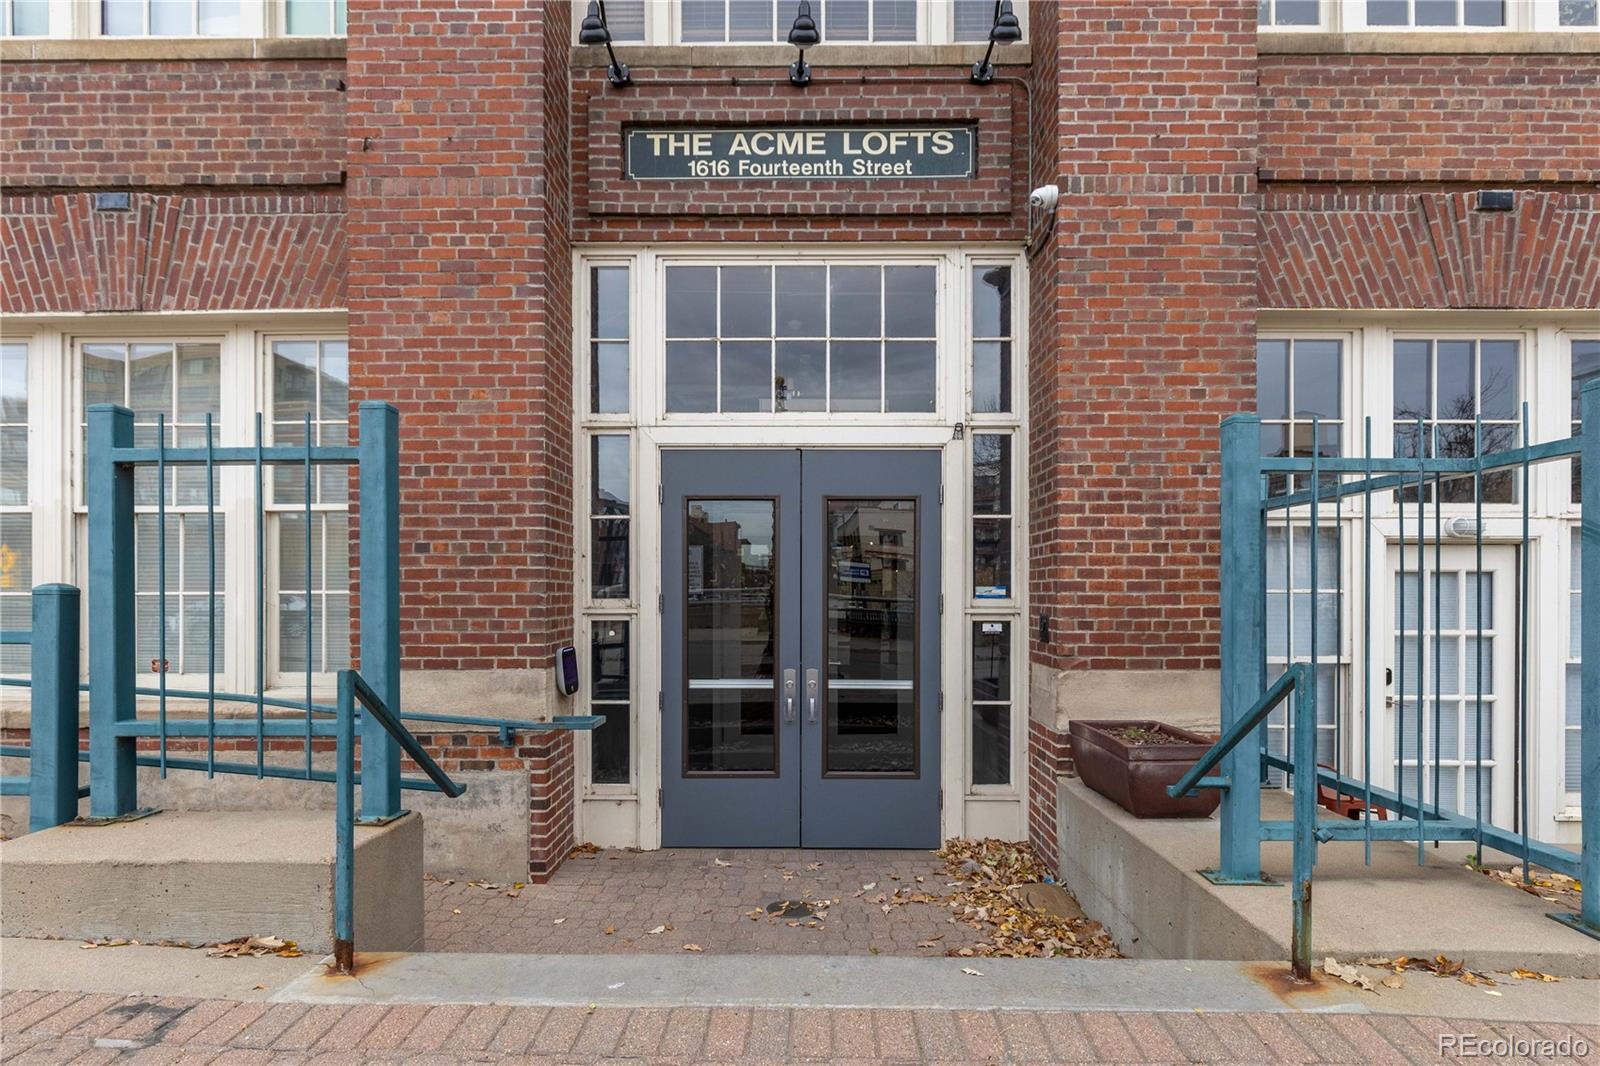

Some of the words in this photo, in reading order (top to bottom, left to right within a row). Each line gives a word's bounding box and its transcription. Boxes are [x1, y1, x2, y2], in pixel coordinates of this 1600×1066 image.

[646, 133, 713, 156] THE
[728, 133, 827, 156] ACME
[842, 131, 955, 155] LOFTS
[687, 160, 730, 176] 1616
[738, 159, 843, 176] Fourteenth
[852, 158, 913, 175] Street
